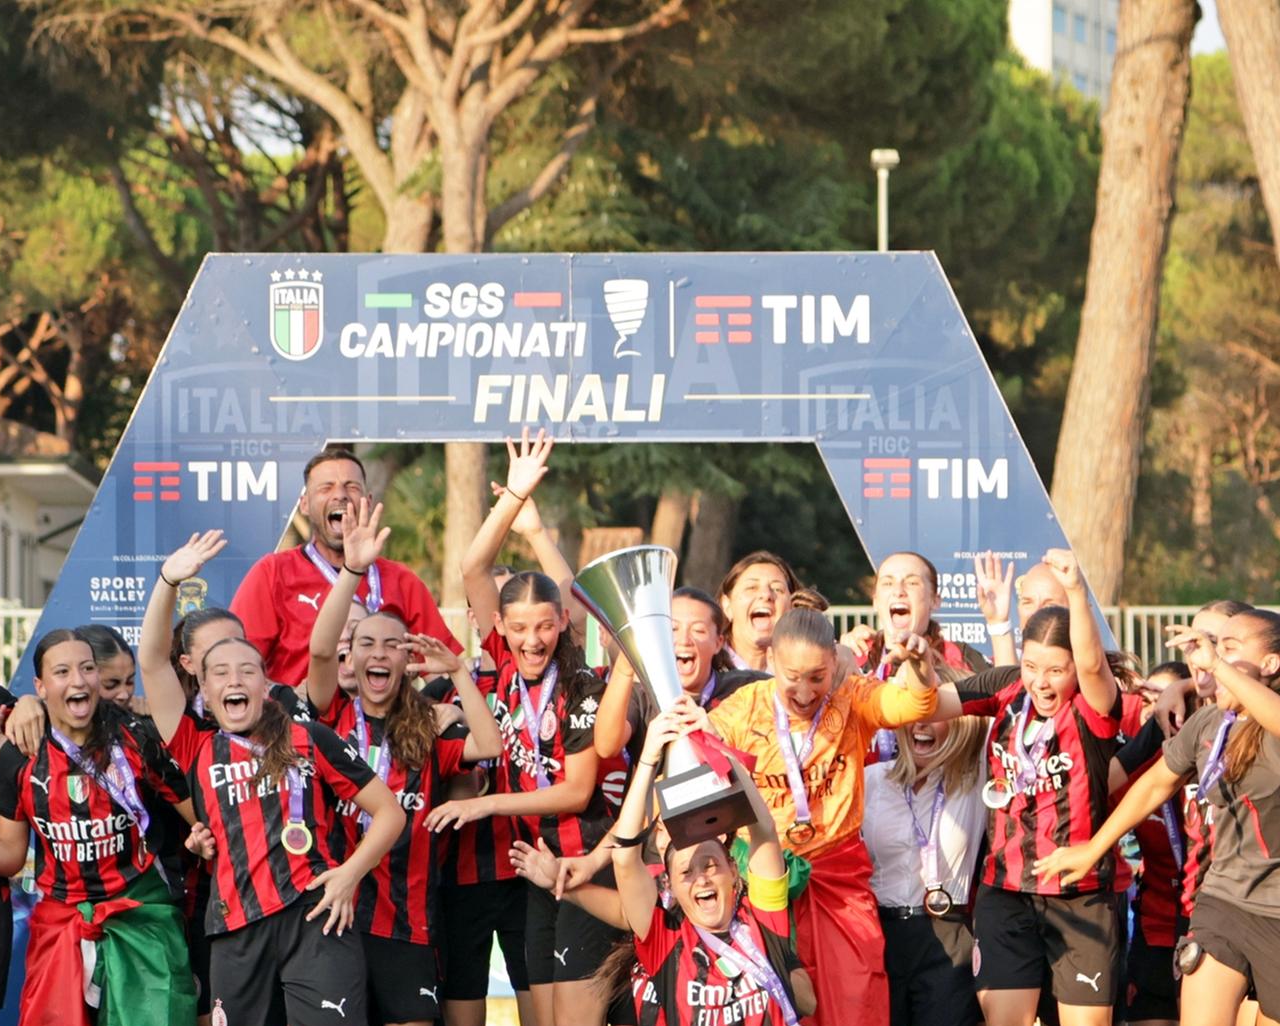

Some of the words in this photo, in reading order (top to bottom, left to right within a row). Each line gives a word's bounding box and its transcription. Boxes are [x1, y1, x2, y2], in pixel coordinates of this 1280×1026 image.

[274, 287, 318, 305] ITALIA
[423, 282, 506, 318] SGS
[761, 295, 870, 344] TIM
[339, 322, 587, 359] CAMPIONATI
[177, 387, 322, 434] ITALIA
[473, 374, 665, 423] FINALI
[816, 385, 963, 431] ITALIA
[230, 439, 273, 456] FIGC
[868, 436, 912, 453] FIGC
[187, 461, 278, 501] TIM
[917, 458, 1008, 499] TIM
[90, 577, 146, 590] SPORT
[937, 574, 976, 587] POR
[937, 587, 977, 599] ALLE
[90, 590, 146, 602] VALLEY
[569, 713, 597, 729] MS
[52, 842, 72, 862] FLY
[76, 833, 124, 862] BETTER
